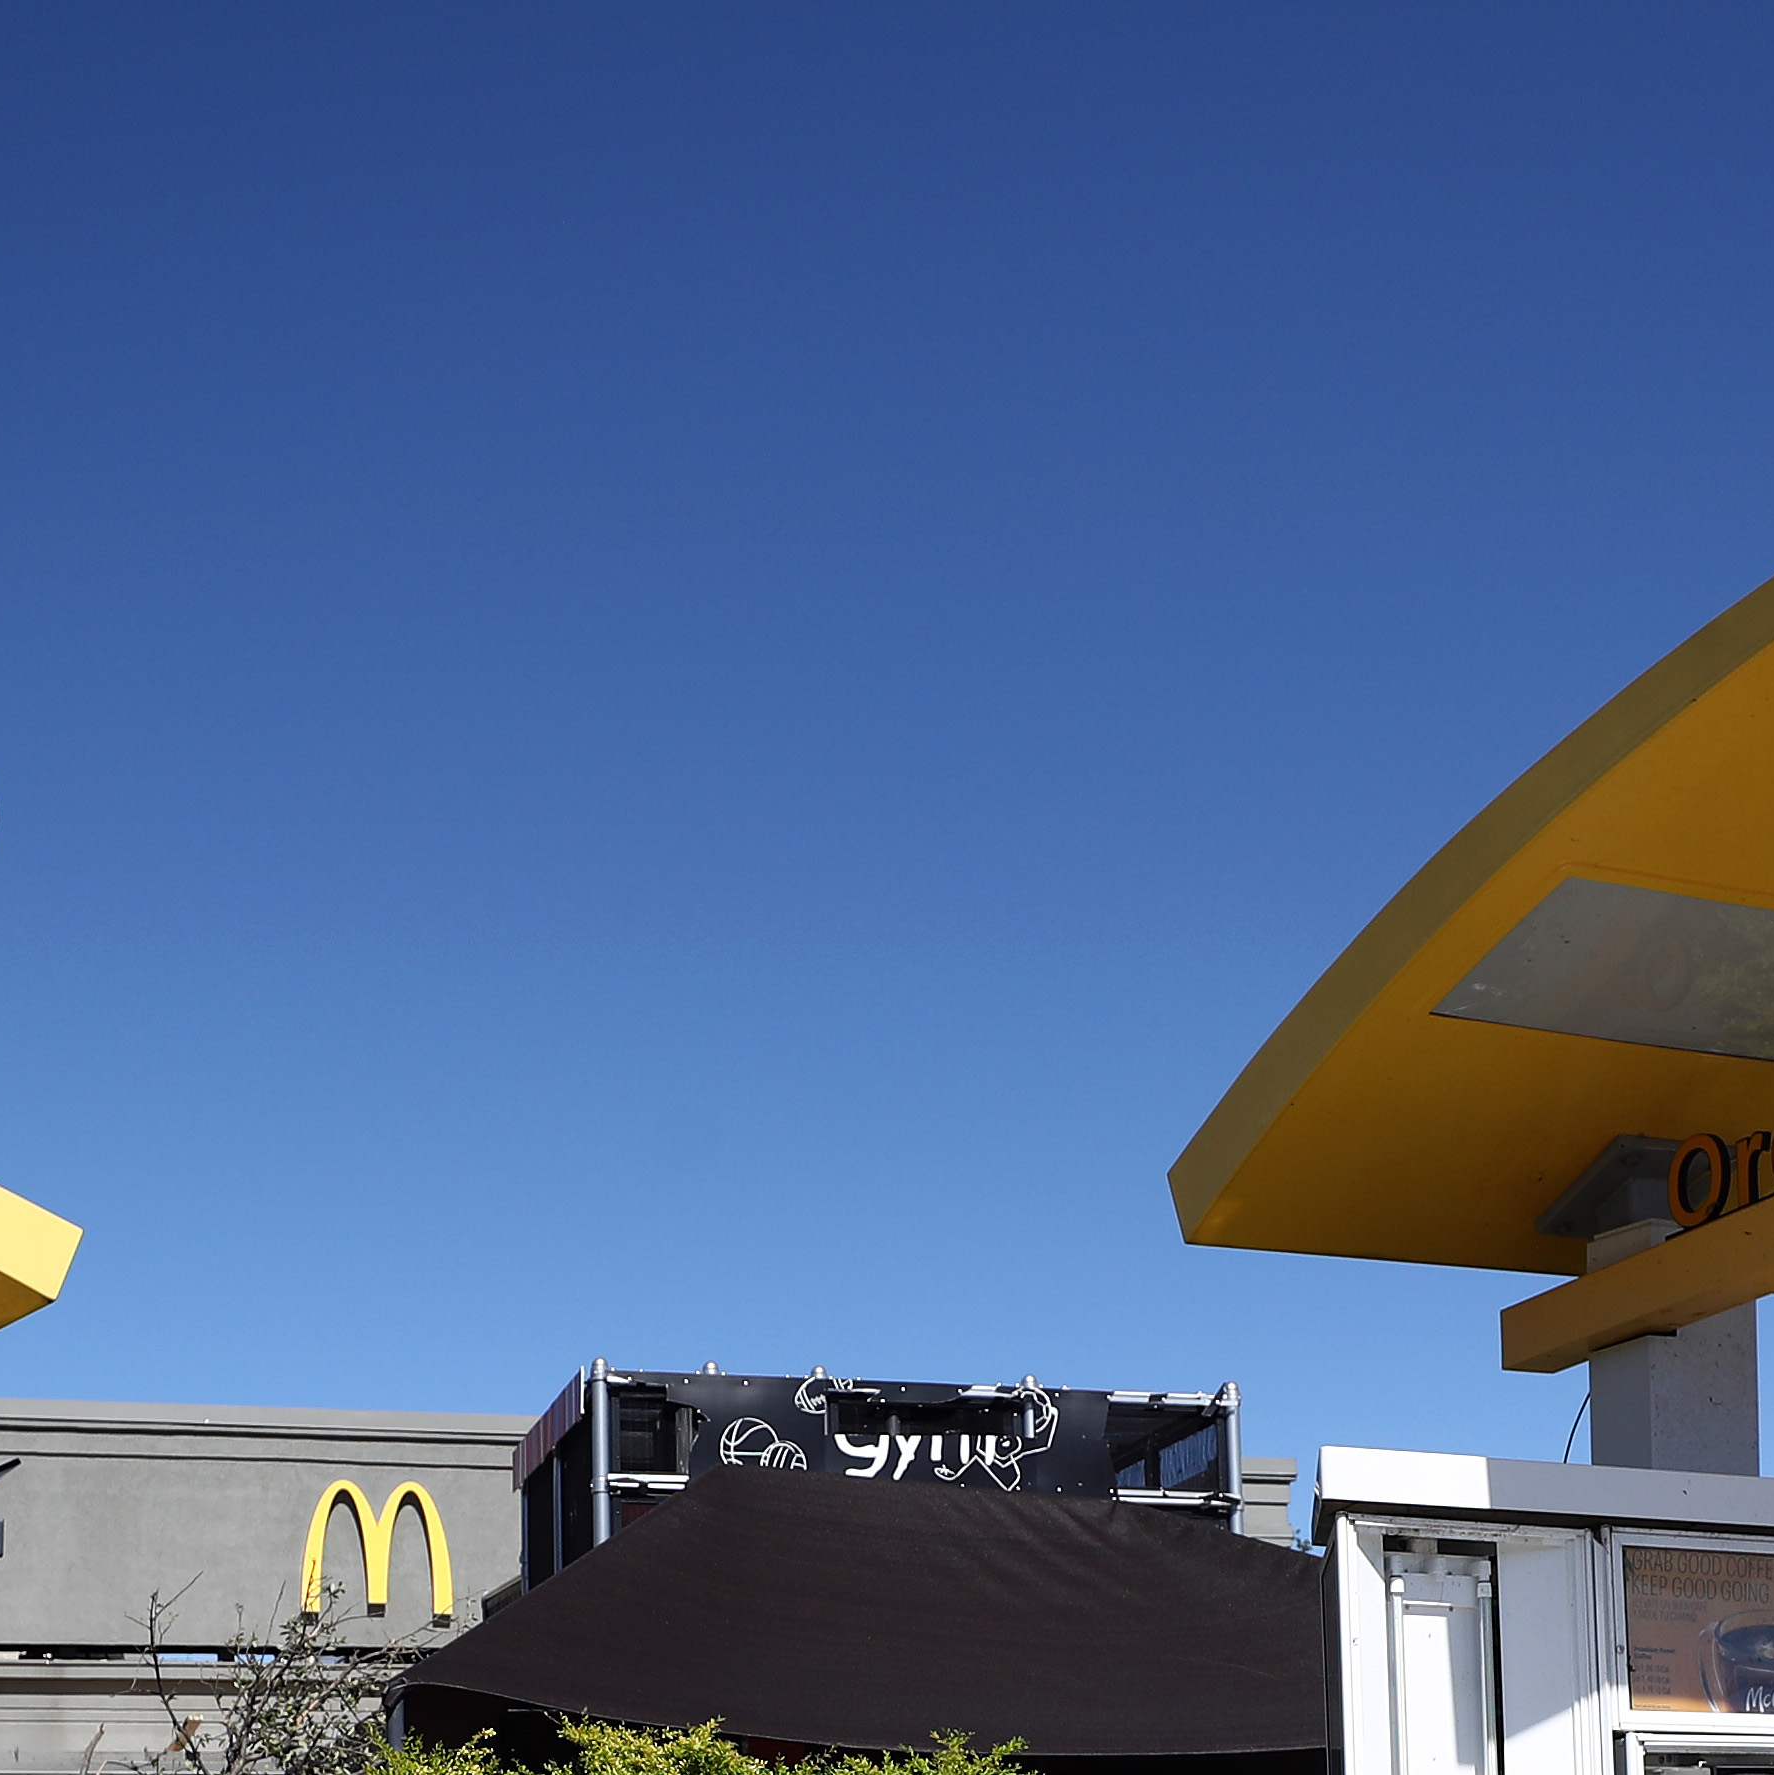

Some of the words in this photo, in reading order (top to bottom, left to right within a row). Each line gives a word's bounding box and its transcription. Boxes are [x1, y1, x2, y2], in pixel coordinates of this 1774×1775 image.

[1632, 1550, 1673, 1572] GRAB
[1677, 1553, 1722, 1577] GOOD
[1632, 1574, 1668, 1596] KEEP
[1672, 1577, 1717, 1601] GOOD
